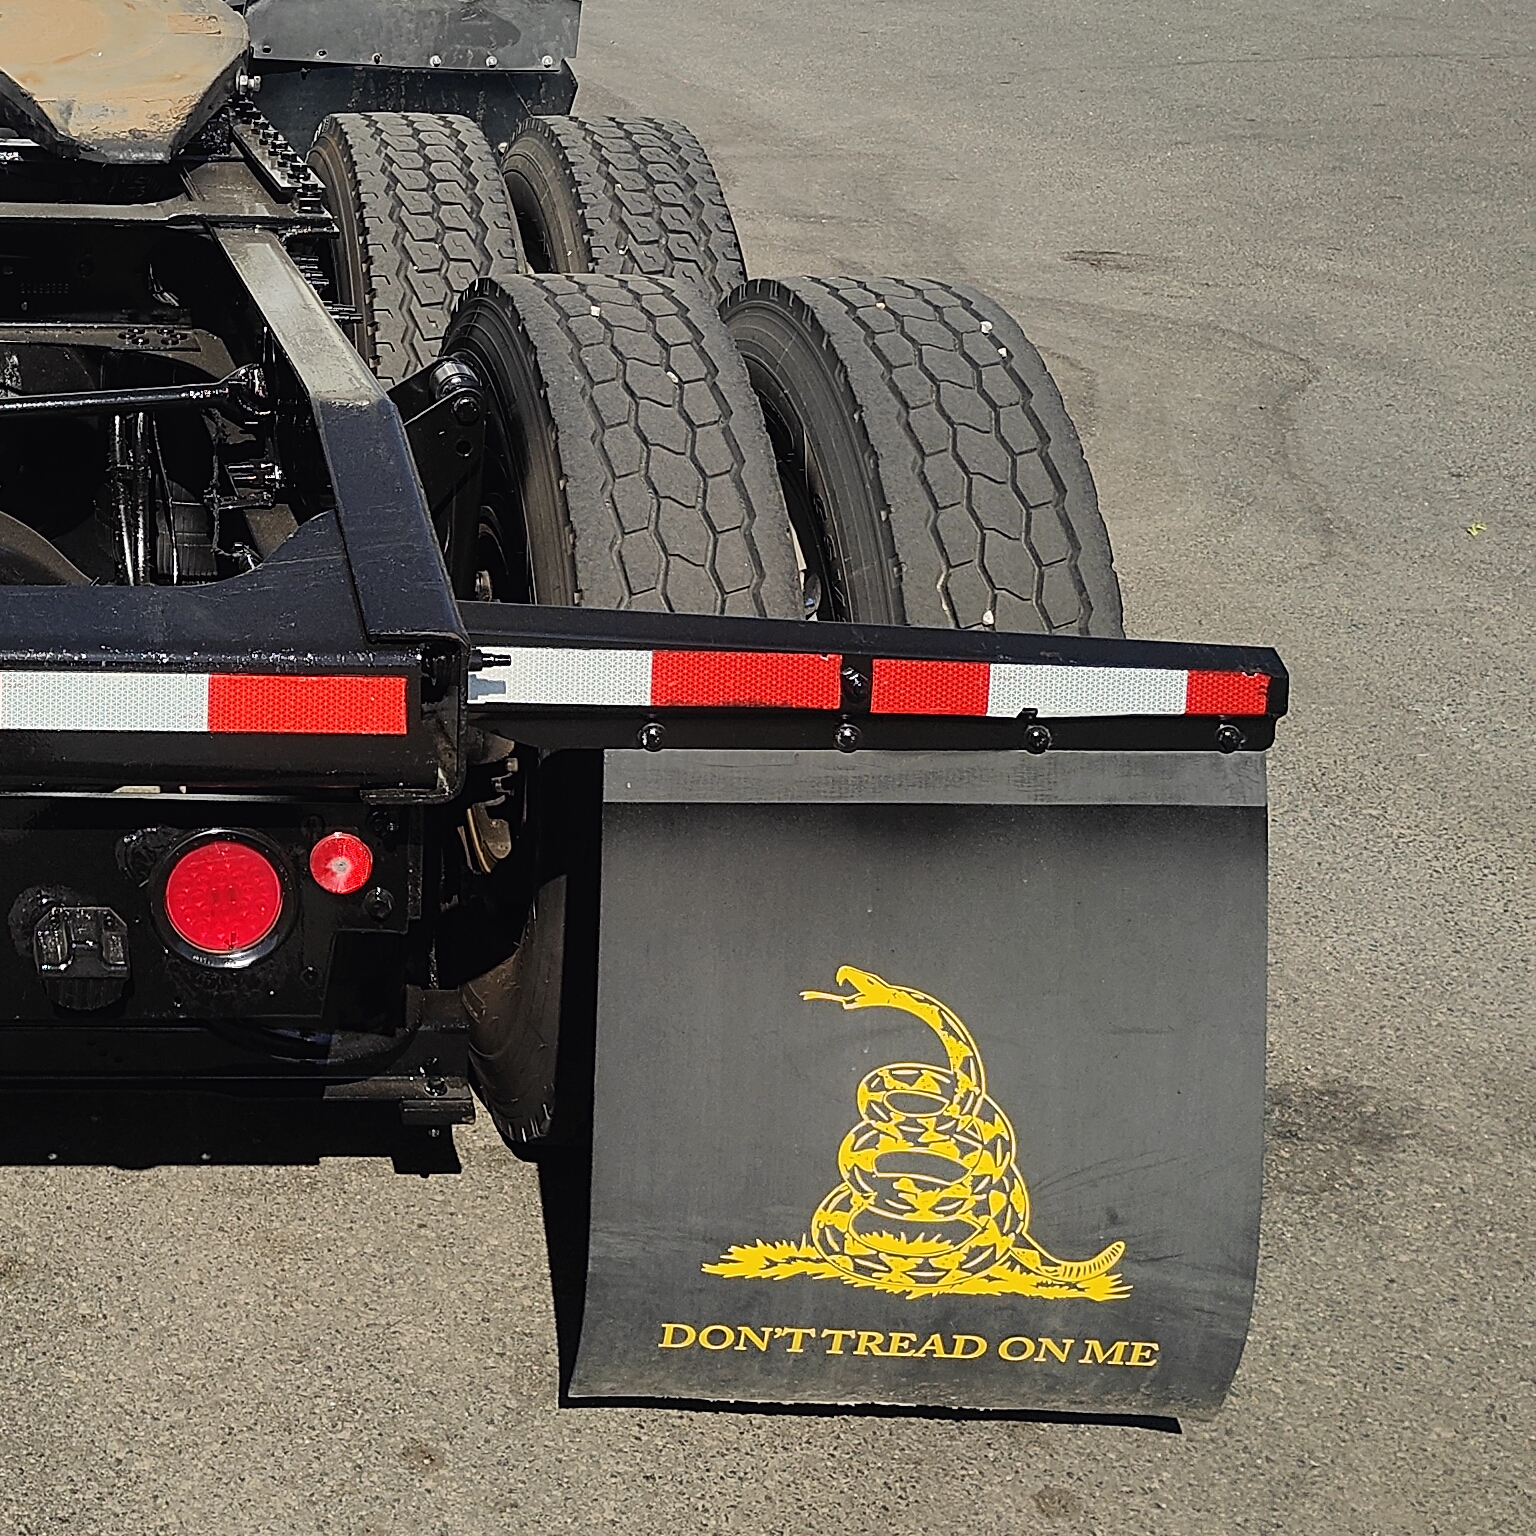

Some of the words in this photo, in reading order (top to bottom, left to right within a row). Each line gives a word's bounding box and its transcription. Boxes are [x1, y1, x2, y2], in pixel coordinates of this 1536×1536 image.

[658, 1322, 817, 1353] DON'T
[820, 1328, 988, 1359] TREAD
[998, 1336, 1076, 1363] ON
[1078, 1339, 1160, 1367] ME
